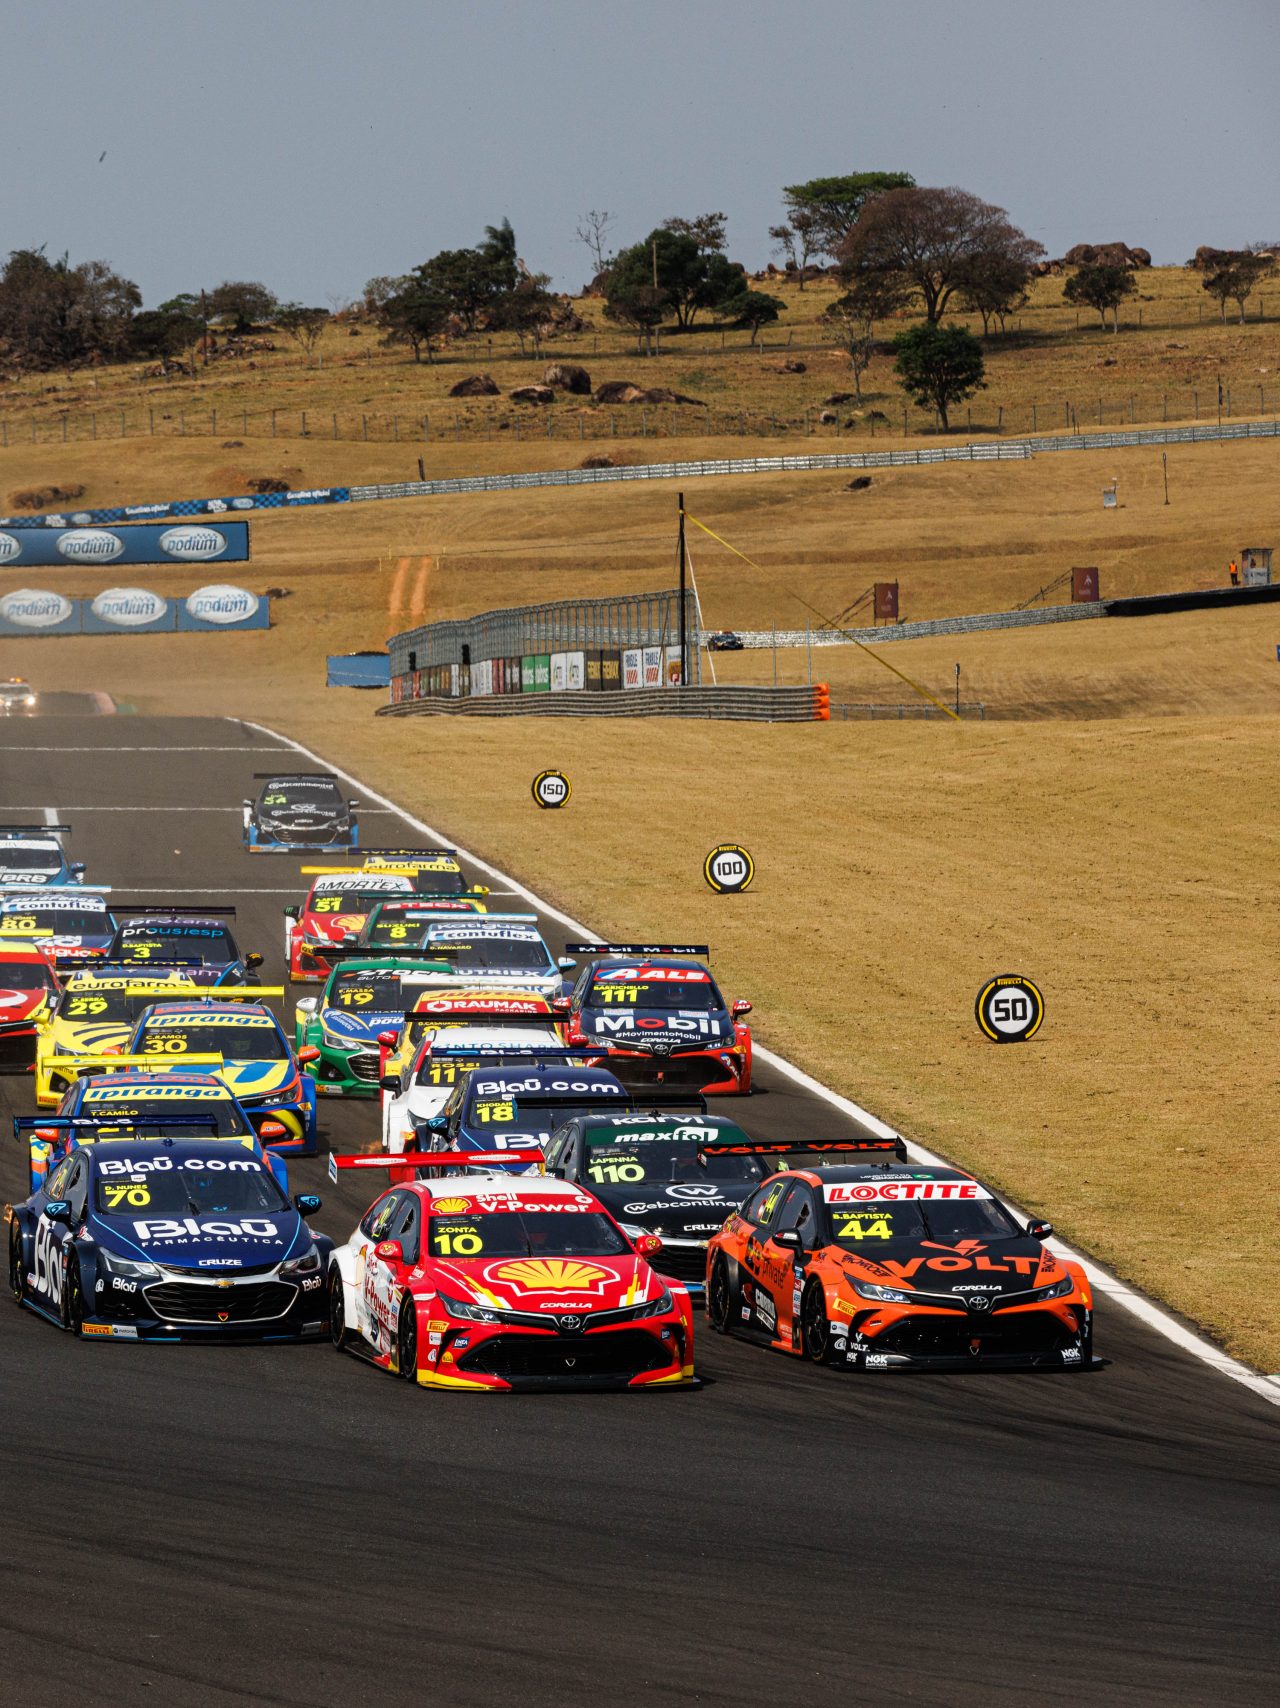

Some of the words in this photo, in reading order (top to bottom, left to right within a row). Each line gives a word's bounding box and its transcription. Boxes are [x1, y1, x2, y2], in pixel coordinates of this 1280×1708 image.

[65, 536, 115, 555] podium
[169, 535, 218, 552] podium
[101, 598, 156, 615] podium
[194, 596, 248, 614] podium
[544, 784, 563, 795] 150
[718, 861, 742, 875] 100
[2, 875, 47, 883] BRB
[316, 880, 403, 890] AMORTEX
[20, 902, 101, 910] contuflex
[315, 902, 341, 912] 51
[1, 920, 36, 929] 80
[390, 927, 407, 938] 8
[448, 931, 534, 940] contuflex
[133, 948, 151, 958] 3
[640, 971, 705, 980] ALE
[340, 993, 374, 1005] 19
[601, 990, 638, 1002] 111
[68, 1002, 108, 1015] 29
[454, 1001, 536, 1010] RAUMAK
[994, 998, 1027, 1022] 50
[595, 1016, 721, 1035] Mobil
[615, 1030, 701, 1041] #MovimentoMobil
[144, 1040, 188, 1053] 30
[477, 1107, 513, 1122] 18
[703, 1145, 793, 1155] VOLT
[808, 1142, 898, 1152] VOLT
[590, 1156, 638, 1164] LAPENNA
[588, 1164, 645, 1184] 110
[105, 1190, 150, 1207] 70
[476, 1193, 517, 1202] Shell
[829, 1184, 977, 1202] LOCTITE
[479, 1202, 589, 1212] V-Power
[838, 1220, 893, 1240] 44
[142, 1236, 284, 1248] FARMACÊUTICA
[434, 1234, 483, 1255] 10
[879, 1256, 1040, 1280] VOLT
[83, 1324, 111, 1334] PIRELLI
[850, 1342, 868, 1351] VOLT
[866, 1355, 887, 1363] NGK
[1061, 1348, 1080, 1358] NGK
